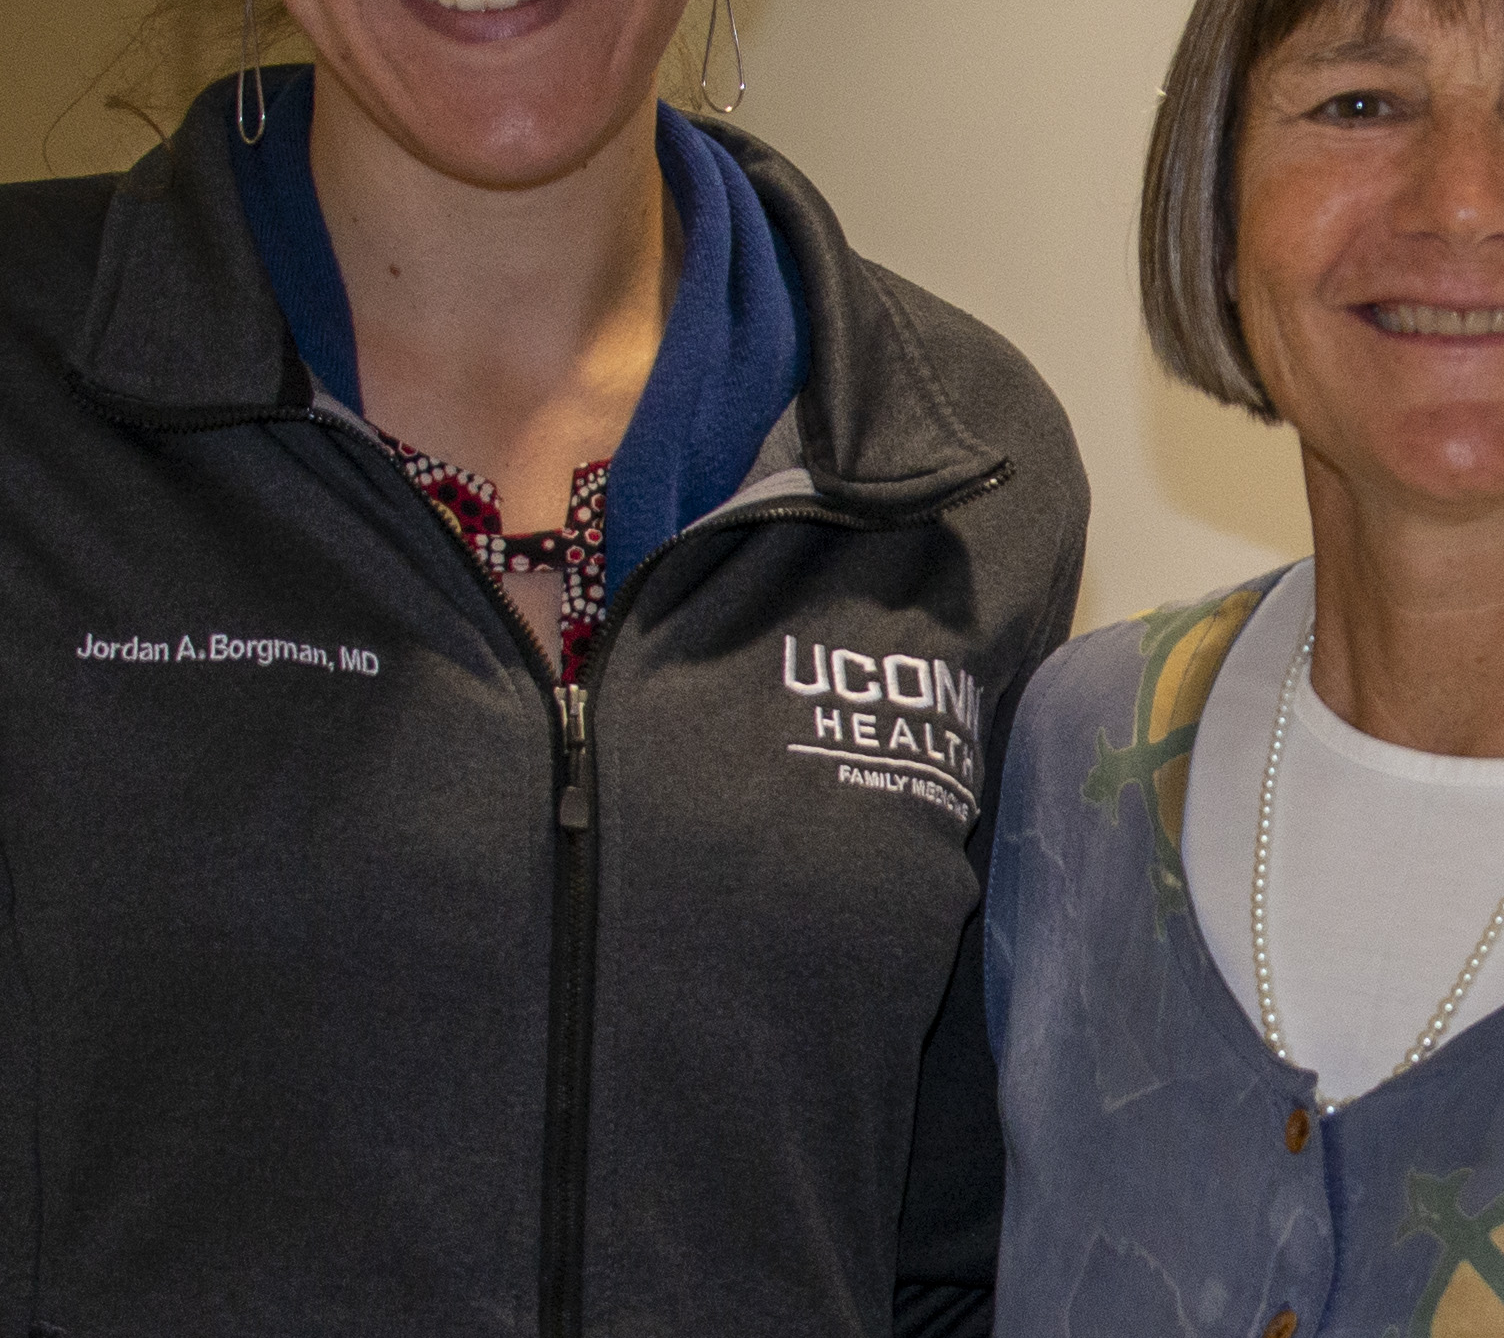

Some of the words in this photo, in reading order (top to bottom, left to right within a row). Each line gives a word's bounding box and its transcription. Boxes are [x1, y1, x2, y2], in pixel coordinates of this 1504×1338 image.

[77, 633, 169, 662] Jordan
[339, 646, 380, 677] MD
[814, 706, 974, 784] HEALTH
[839, 765, 909, 791] FAMILY
